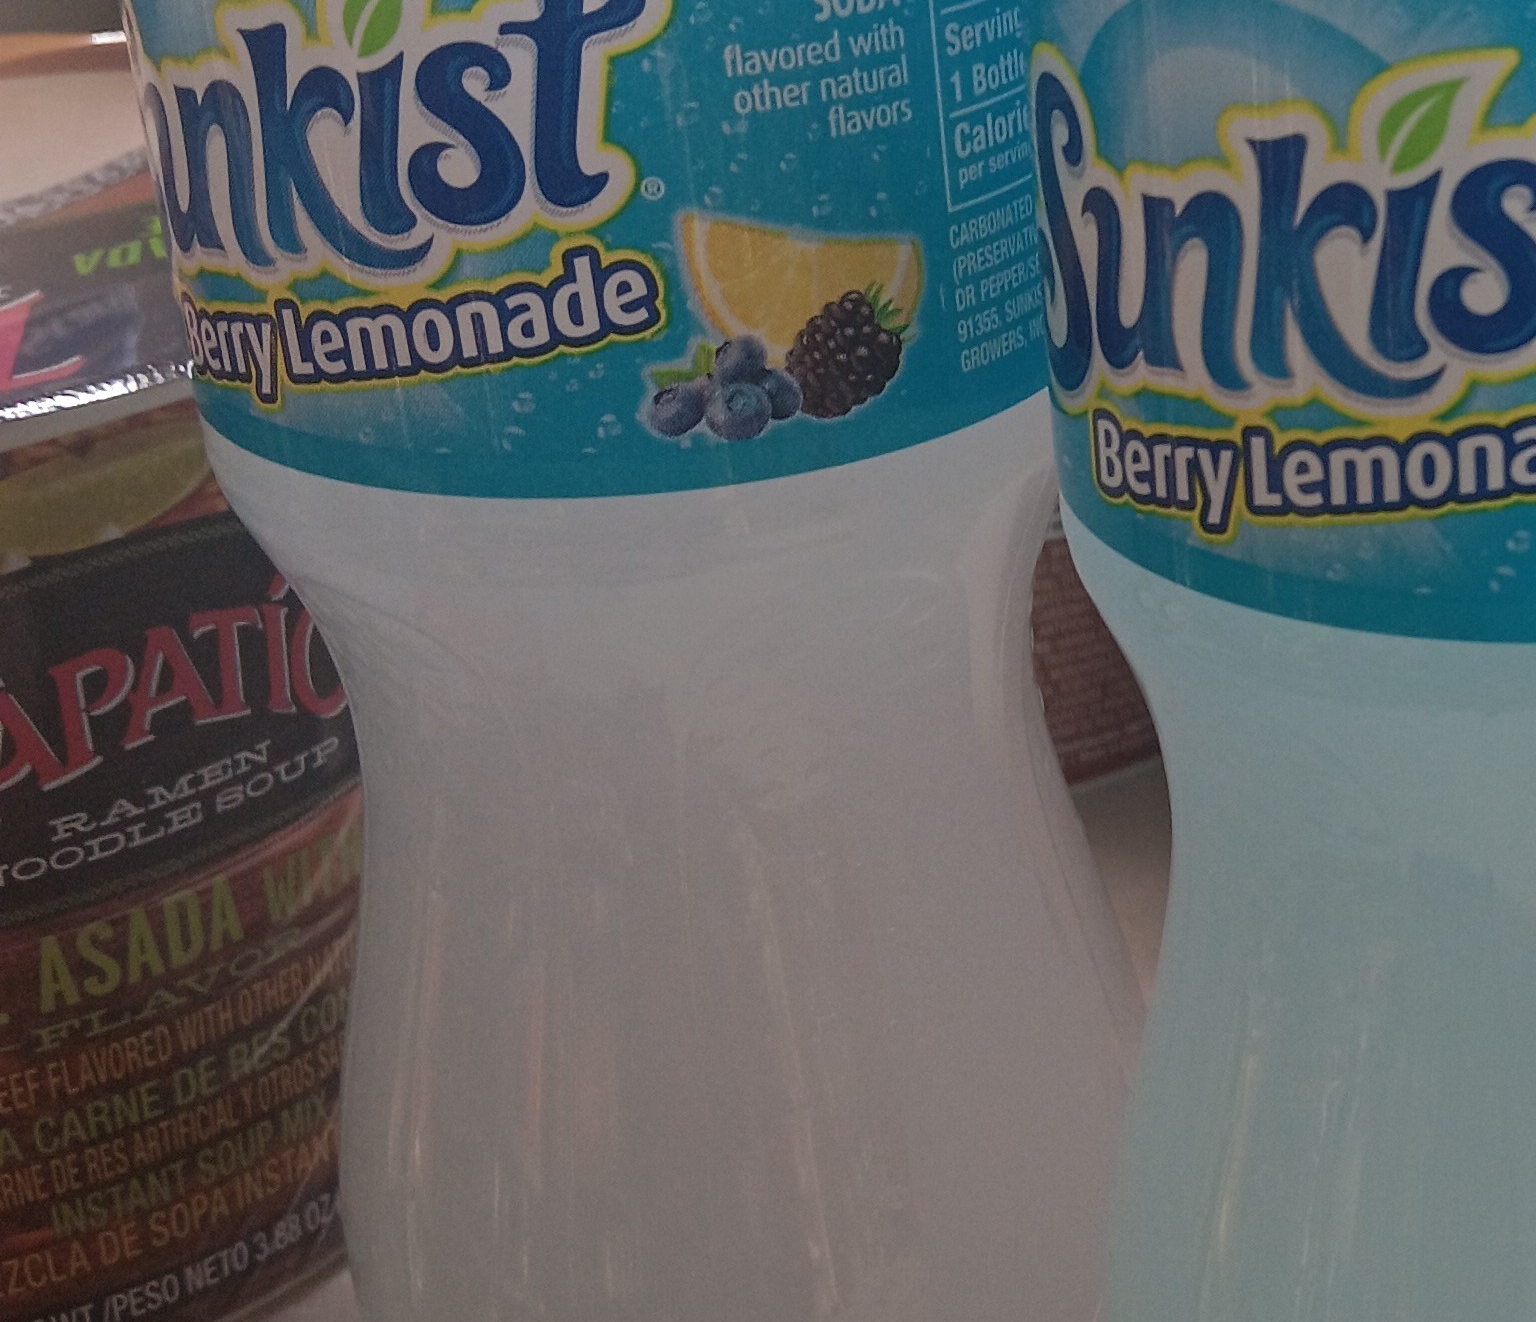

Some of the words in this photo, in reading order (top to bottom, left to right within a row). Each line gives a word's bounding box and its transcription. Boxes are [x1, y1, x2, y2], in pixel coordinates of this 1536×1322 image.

[723, 28, 841, 78] flavored
[848, 17, 905, 55] with
[732, 79, 810, 116] other
[819, 53, 909, 102] natural
[949, 69, 963, 104] 1
[828, 95, 913, 140] flavors
[958, 160, 985, 191] per
[949, 193, 1033, 250] CARBONATED
[280, 253, 654, 377] Lemonade
[1095, 416, 1236, 525] Berry
[49, 738, 272, 842] RAMEN
[214, 735, 340, 814] SOUP
[38, 871, 245, 1015] ASADA
[45, 1024, 173, 1098] FLAVORED
[175, 994, 235, 1053] WITH
[237, 961, 304, 1026] OTHER
[32, 1079, 166, 1155] CARNE
[171, 1055, 222, 1106] DE
[227, 1029, 291, 1081] RES
[50, 1152, 83, 1195] DE
[83, 1138, 130, 1193] RES
[132, 1095, 240, 1167] ARTIFICIAL
[50, 1158, 188, 1239] INSTANT
[195, 1119, 274, 1185] SOUP
[279, 1088, 329, 1146] MIX
[100, 1220, 143, 1267] DE
[149, 1186, 230, 1249] SOPA
[184, 1240, 250, 1294] NETO
[251, 1211, 302, 1263] 3.88
